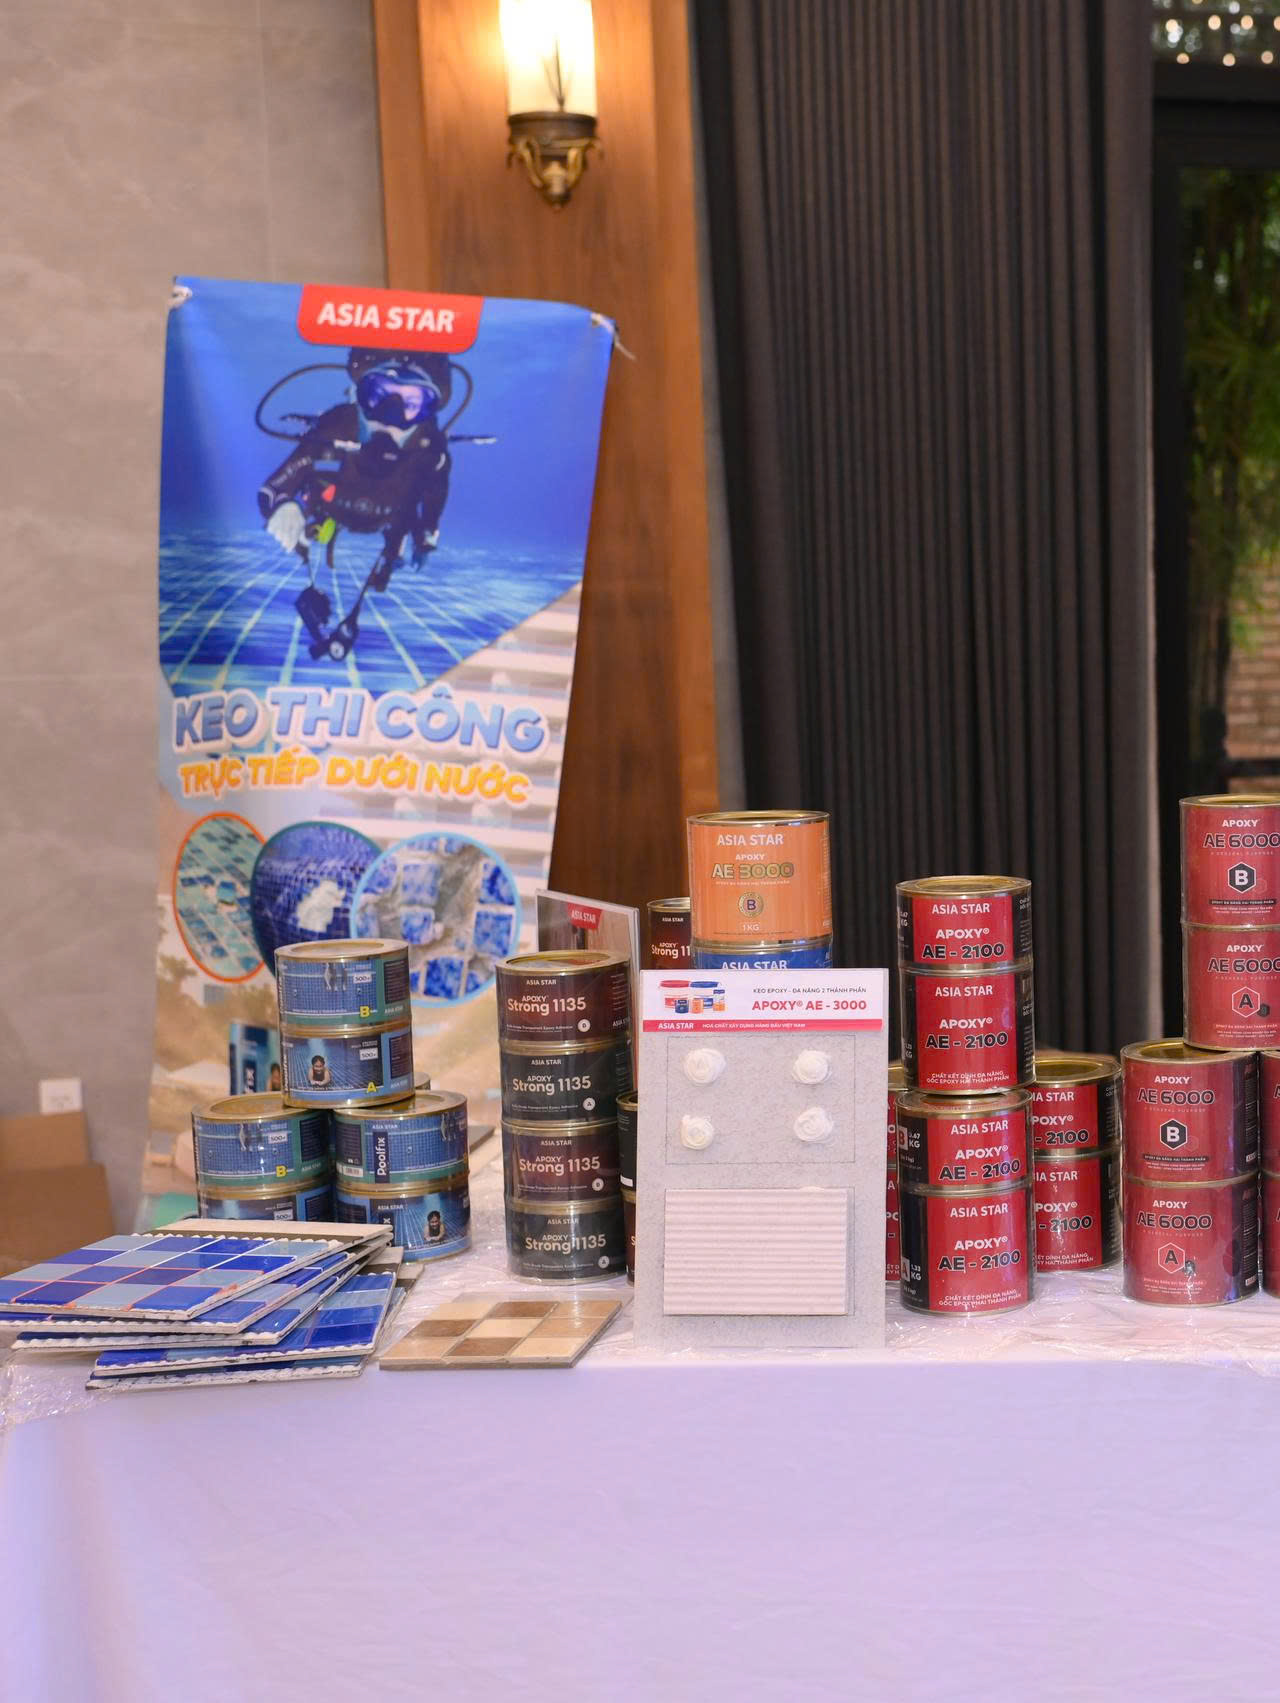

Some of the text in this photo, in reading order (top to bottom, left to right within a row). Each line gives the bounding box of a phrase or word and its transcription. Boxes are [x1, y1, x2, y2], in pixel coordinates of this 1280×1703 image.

[316, 302, 454, 333] ASIA STAR
[175, 686, 546, 752] KEO THI CÔNG
[180, 748, 529, 802] TRỰC TIẾP DƯỚI NƯỚC
[1222, 819, 1258, 828] APOXY
[717, 834, 784, 846] ASIA STAR
[1204, 833, 1280, 848] AE 6000
[712, 862, 794, 879] AE 3000
[1235, 870, 1249, 886] B
[747, 899, 756, 910] B
[932, 903, 990, 915] ASIA STAR
[571, 910, 597, 924] ASIA STAR
[651, 944, 679, 959] Strong
[922, 944, 1005, 959] AE 2100
[1226, 945, 1263, 953] APOXY
[1208, 958, 1229, 973] AE
[935, 985, 993, 997] ASIA STAR
[508, 996, 586, 1016] Strong 1135
[806, 1000, 822, 1010] AE
[833, 1000, 867, 1010] 3000
[1239, 994, 1254, 1009] A
[360, 1006, 370, 1018] B
[925, 1032, 1008, 1049] AE 2100
[367, 1081, 377, 1093] A
[512, 1075, 592, 1096] Strong 1135
[1154, 1075, 1190, 1085] APOXY
[1046, 1092, 1075, 1102] STAR
[1138, 1088, 1215, 1105] AE 6000
[951, 1120, 1008, 1135] ASIA STAR
[1167, 1127, 1180, 1142] B
[1046, 1129, 1089, 1145] 2100
[376, 1136, 388, 1177] Poolfix
[276, 1165, 287, 1177] B
[519, 1156, 600, 1176] Strong 1135
[939, 1160, 1020, 1181] AE 2100
[1050, 1171, 1078, 1181] STAR
[950, 1203, 1008, 1218] ASIA STAR
[1153, 1200, 1187, 1209] APOXY
[1051, 1216, 1092, 1232] 2100
[1136, 1212, 1212, 1230] AE 6000
[525, 1234, 606, 1254] Strong 1135
[938, 1250, 1021, 1271] AE 2100
[1165, 1250, 1178, 1265] A
[911, 1272, 922, 1281] KG
